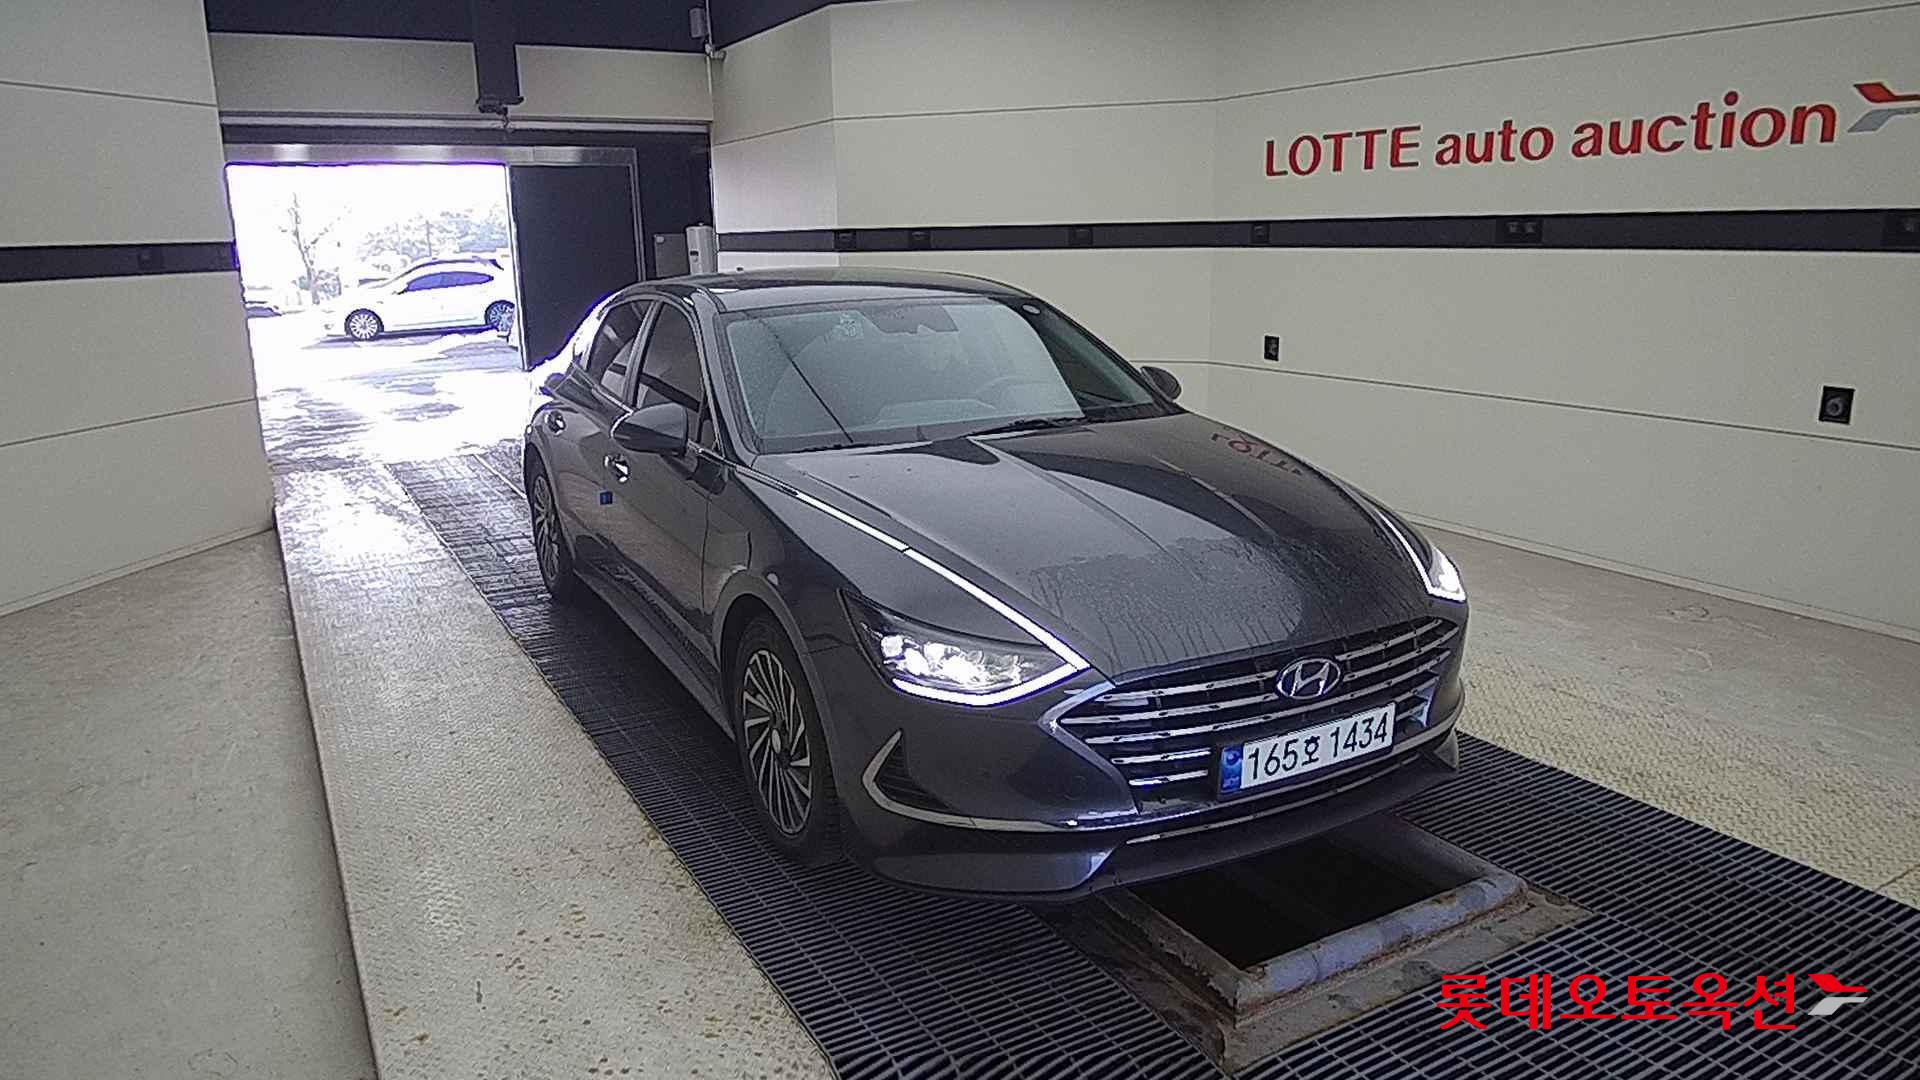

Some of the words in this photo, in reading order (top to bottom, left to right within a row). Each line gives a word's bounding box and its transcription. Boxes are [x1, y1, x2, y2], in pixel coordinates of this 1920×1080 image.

[1264, 126, 1423, 178] LOTTE
[1433, 120, 1555, 167] auto
[1570, 90, 1838, 160] auction
[1330, 711, 1389, 758] 1434
